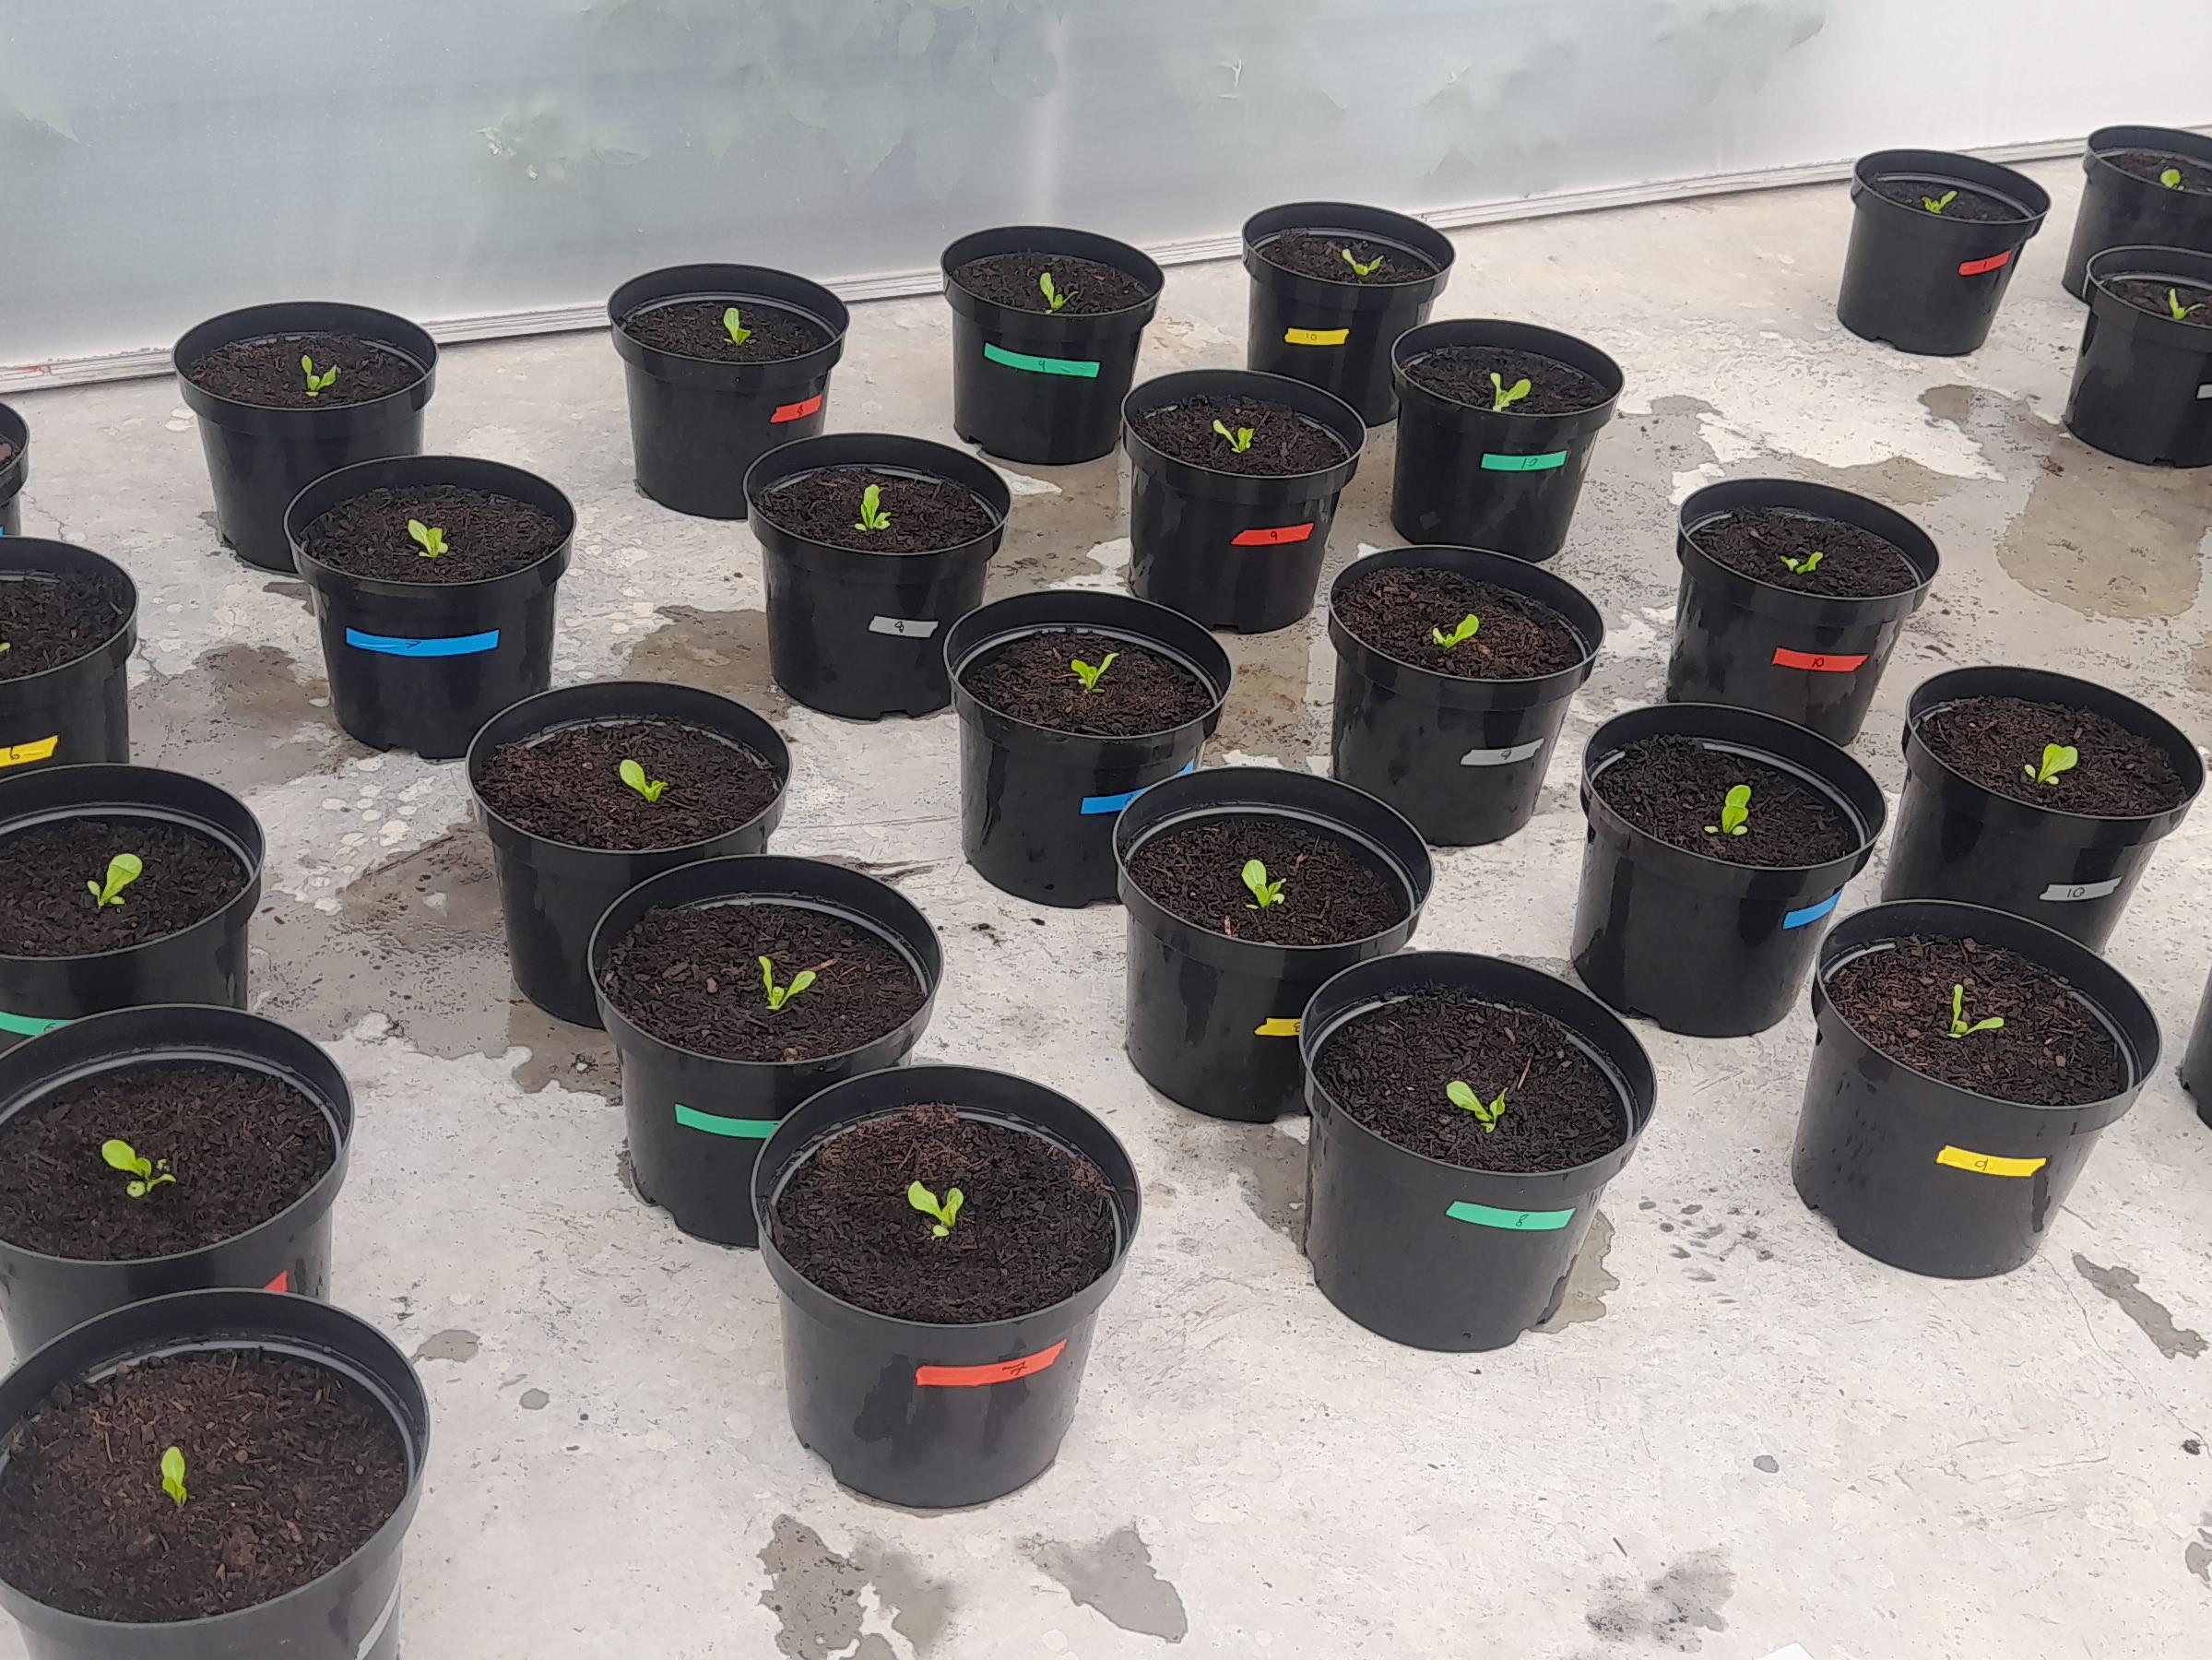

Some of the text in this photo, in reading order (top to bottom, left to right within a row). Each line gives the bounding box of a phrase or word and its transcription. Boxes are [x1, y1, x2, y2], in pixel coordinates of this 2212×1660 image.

[1270, 531, 1278, 540] 9
[1812, 658, 1824, 667] 10
[10, 745, 20, 760] 6
[1501, 750, 1512, 760] 9
[2067, 887, 2085, 897] 10
[1974, 1158, 1988, 1171] 9
[1515, 1214, 1529, 1227] 8
